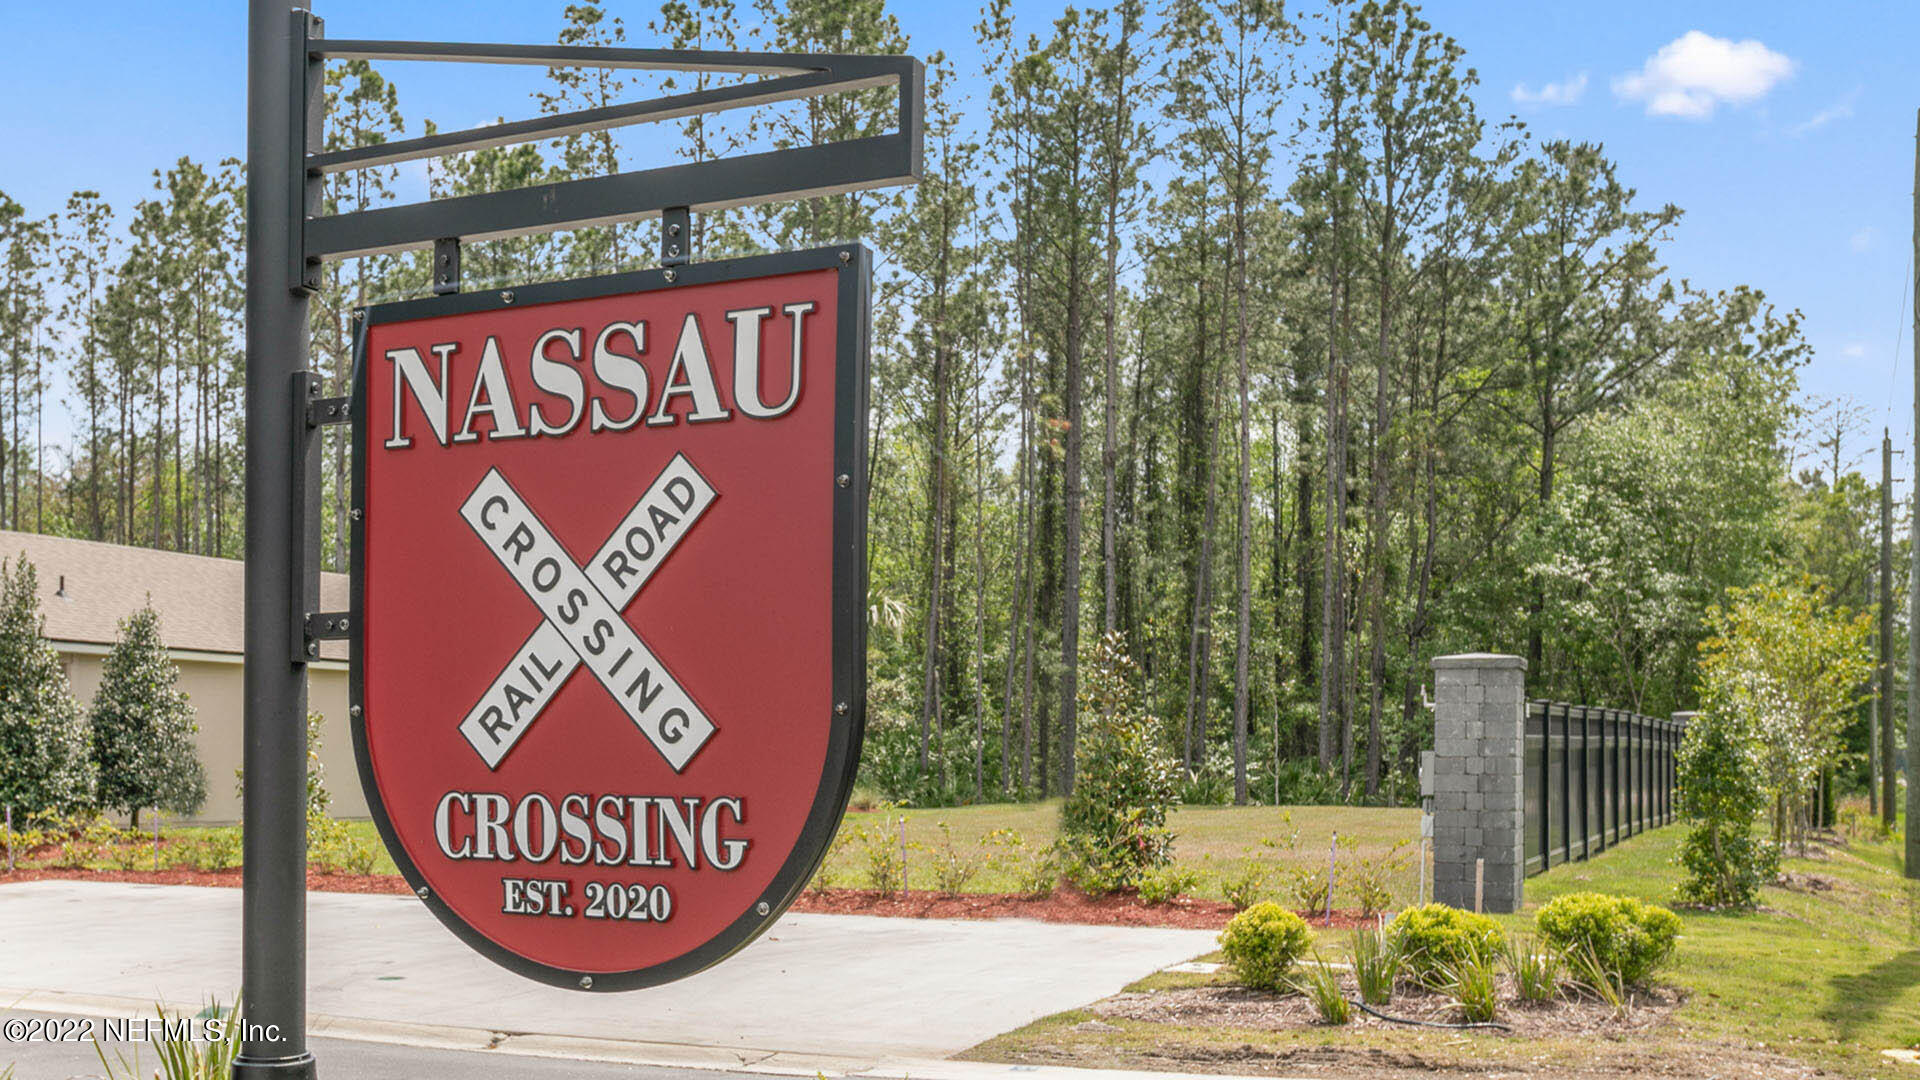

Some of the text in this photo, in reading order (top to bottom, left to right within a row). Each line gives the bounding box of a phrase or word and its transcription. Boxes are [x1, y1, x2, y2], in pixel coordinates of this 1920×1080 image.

[384, 301, 816, 450] NASSAU
[477, 476, 696, 745] RAIL ROAD
[480, 495, 690, 744] CROSSING
[434, 791, 750, 871] CROSSING
[502, 878, 672, 922] EST. 2020
